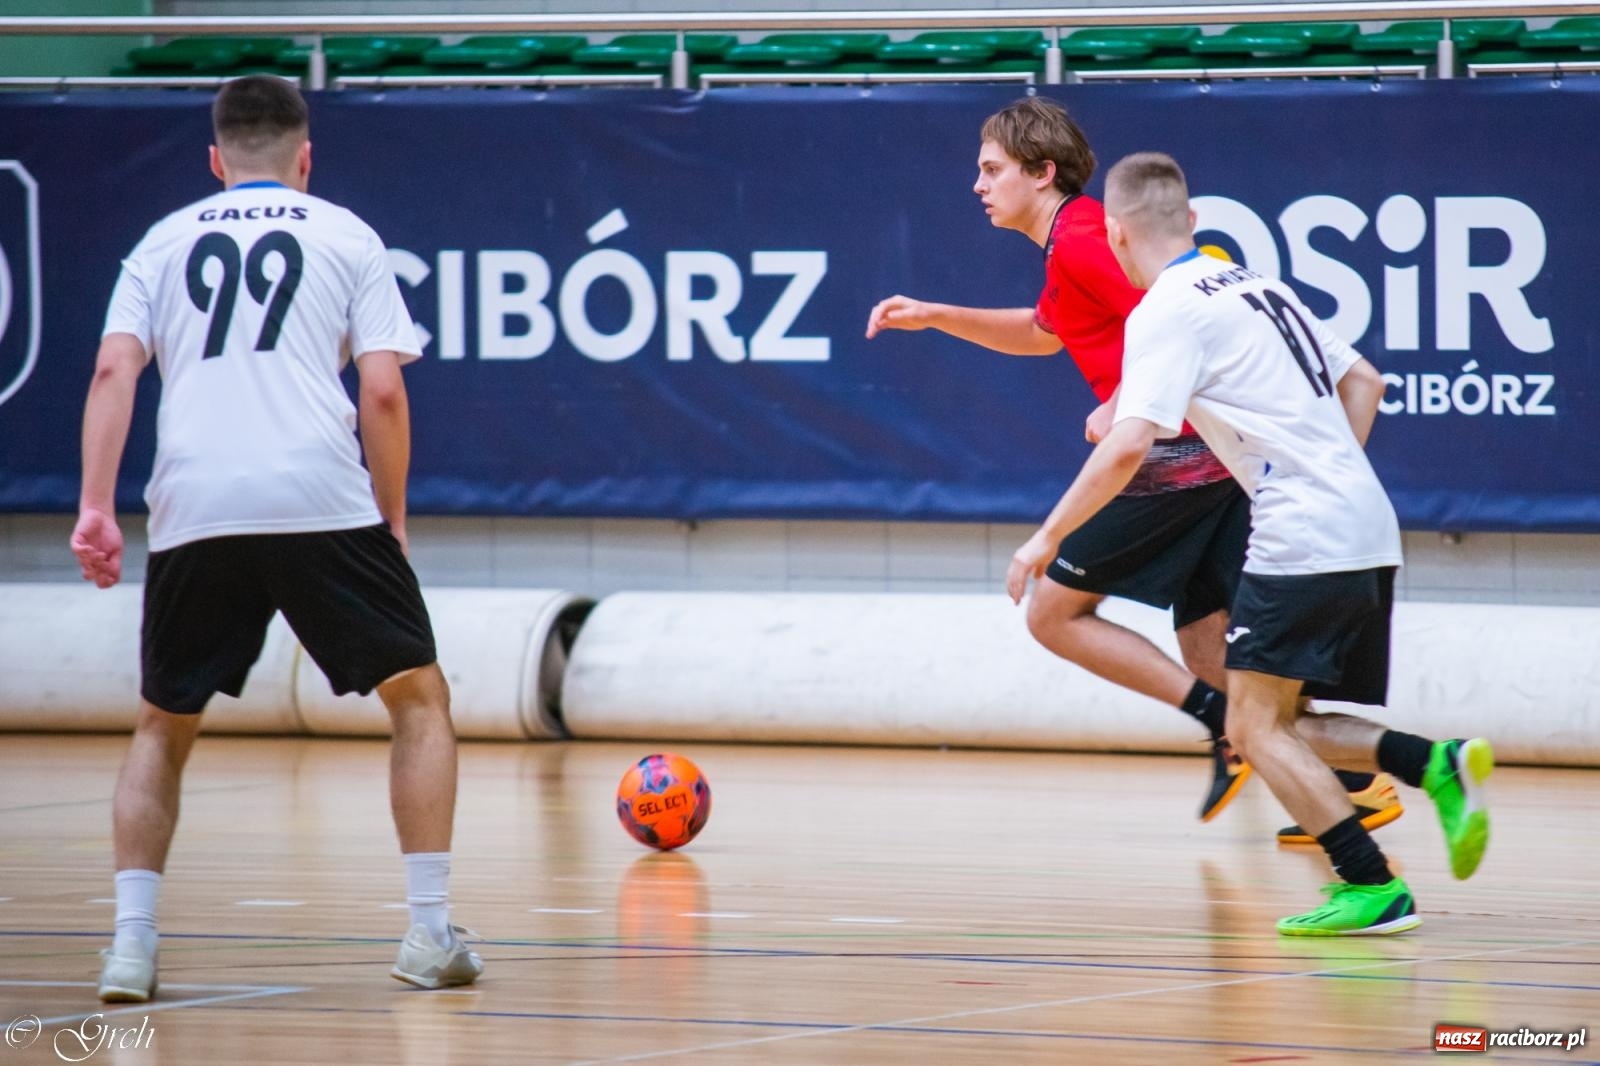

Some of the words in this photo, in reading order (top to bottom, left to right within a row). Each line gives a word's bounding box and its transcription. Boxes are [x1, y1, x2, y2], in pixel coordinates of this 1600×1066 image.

[198, 206, 308, 222] GACUS
[185, 230, 304, 360] 99
[1240, 289, 1333, 398] 10
[638, 793, 688, 816] SELECT
